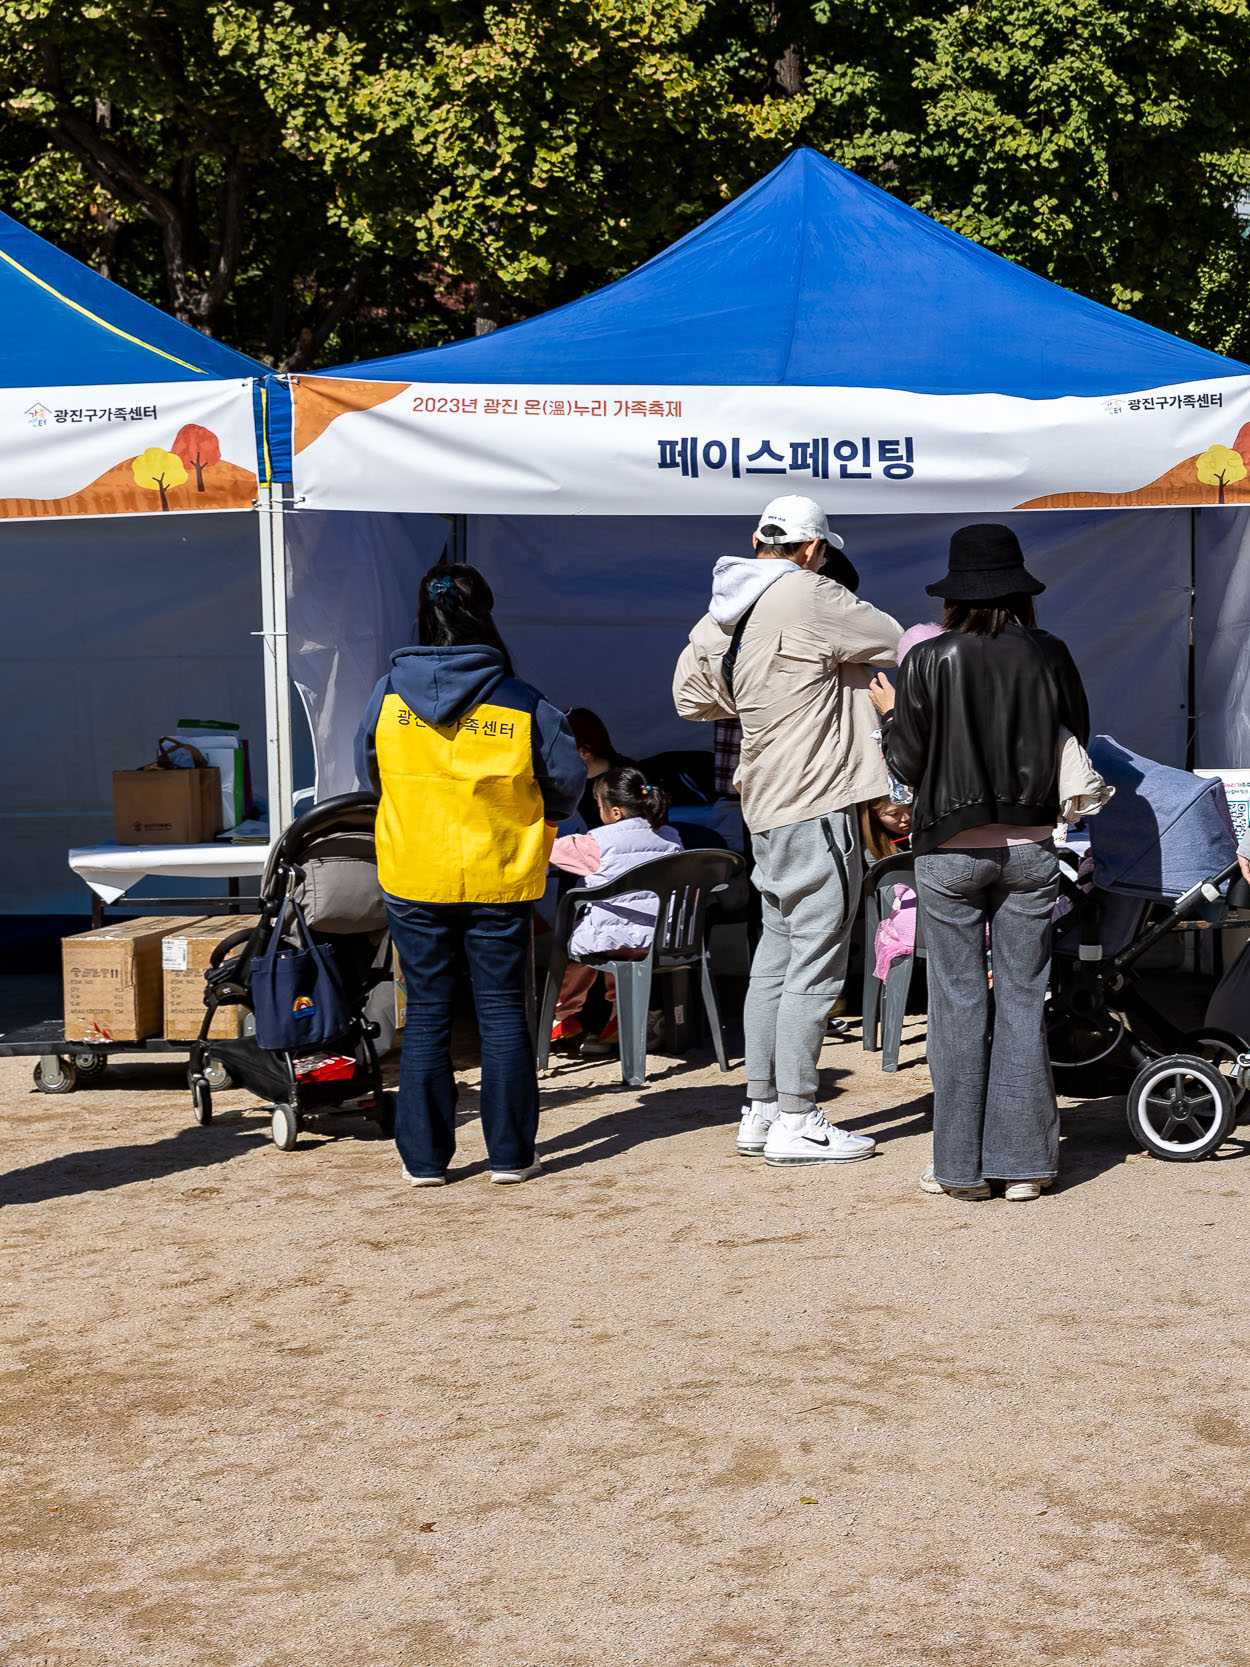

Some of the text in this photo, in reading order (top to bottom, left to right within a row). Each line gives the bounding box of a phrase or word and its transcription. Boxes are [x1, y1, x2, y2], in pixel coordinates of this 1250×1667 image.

[412, 397, 682, 418] 2023년 광진 온(溫)누리 가족축제
[1128, 393, 1223, 411] 광진구가족센터
[53, 405, 157, 423] 광진구가족센터
[657, 437, 915, 480] 페이스페인팅
